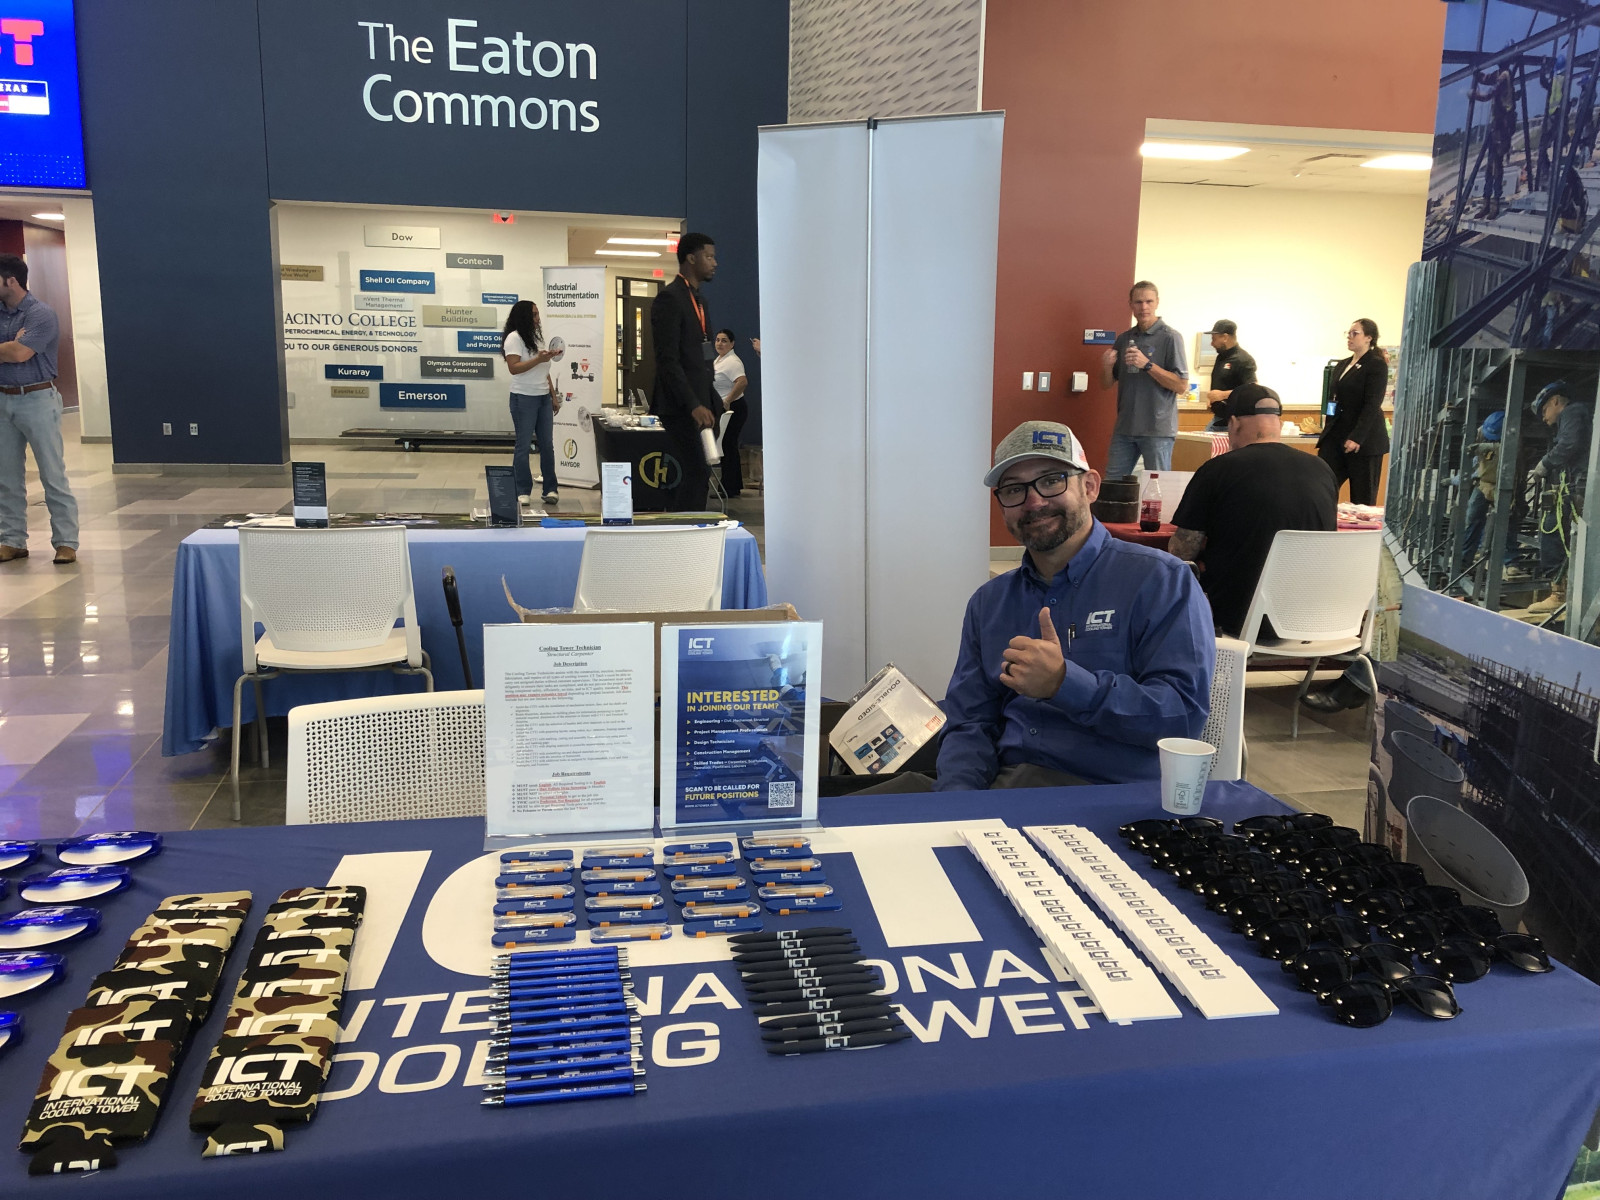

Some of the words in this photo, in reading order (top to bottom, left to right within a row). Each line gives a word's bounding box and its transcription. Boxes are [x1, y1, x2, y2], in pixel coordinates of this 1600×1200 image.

[0, 19, 44, 65] T
[358, 22, 433, 63] The
[448, 18, 596, 79] Eaton
[0, 83, 28, 92] EXAS
[363, 74, 600, 132] Commons
[392, 232, 413, 242] Dow
[457, 257, 492, 265] Contech
[285, 313, 343, 325] ACINTO
[349, 313, 416, 327] COLLEGE
[338, 368, 370, 377] Kuraray
[398, 391, 447, 400] Emerson
[1032, 431, 1066, 444] ICT
[1086, 610, 1115, 624] ICT
[689, 638, 714, 649] ICT
[687, 690, 779, 704] INTERESTED
[858, 679, 901, 721] DOUBLE-SIDED
[777, 930, 798, 939] ICT
[781, 939, 803, 948] ICT
[259, 949, 341, 967] ICT
[784, 948, 806, 958] ICT
[789, 958, 811, 968] ICT
[794, 968, 817, 978] ICT
[250, 978, 336, 998] ICT
[799, 977, 822, 987] ICT
[96, 981, 188, 1006] ICT
[802, 987, 826, 998] ICT
[809, 999, 833, 1010] ICT
[816, 1011, 841, 1023] ICT
[235, 1013, 327, 1037] ICT
[819, 1023, 844, 1035] ICT
[73, 1019, 172, 1046] ICT
[826, 1036, 850, 1048] ICT
[212, 1053, 313, 1085] ICT
[48, 1065, 155, 1101] ICT
[209, 1082, 302, 1094] INTERNATIONAL
[204, 1091, 255, 1103] COOLING
[259, 1088, 301, 1098] TOWER
[44, 1096, 140, 1111] INTERNATIONAL
[39, 1106, 92, 1119] COOLING
[96, 1104, 140, 1113] TOWER
